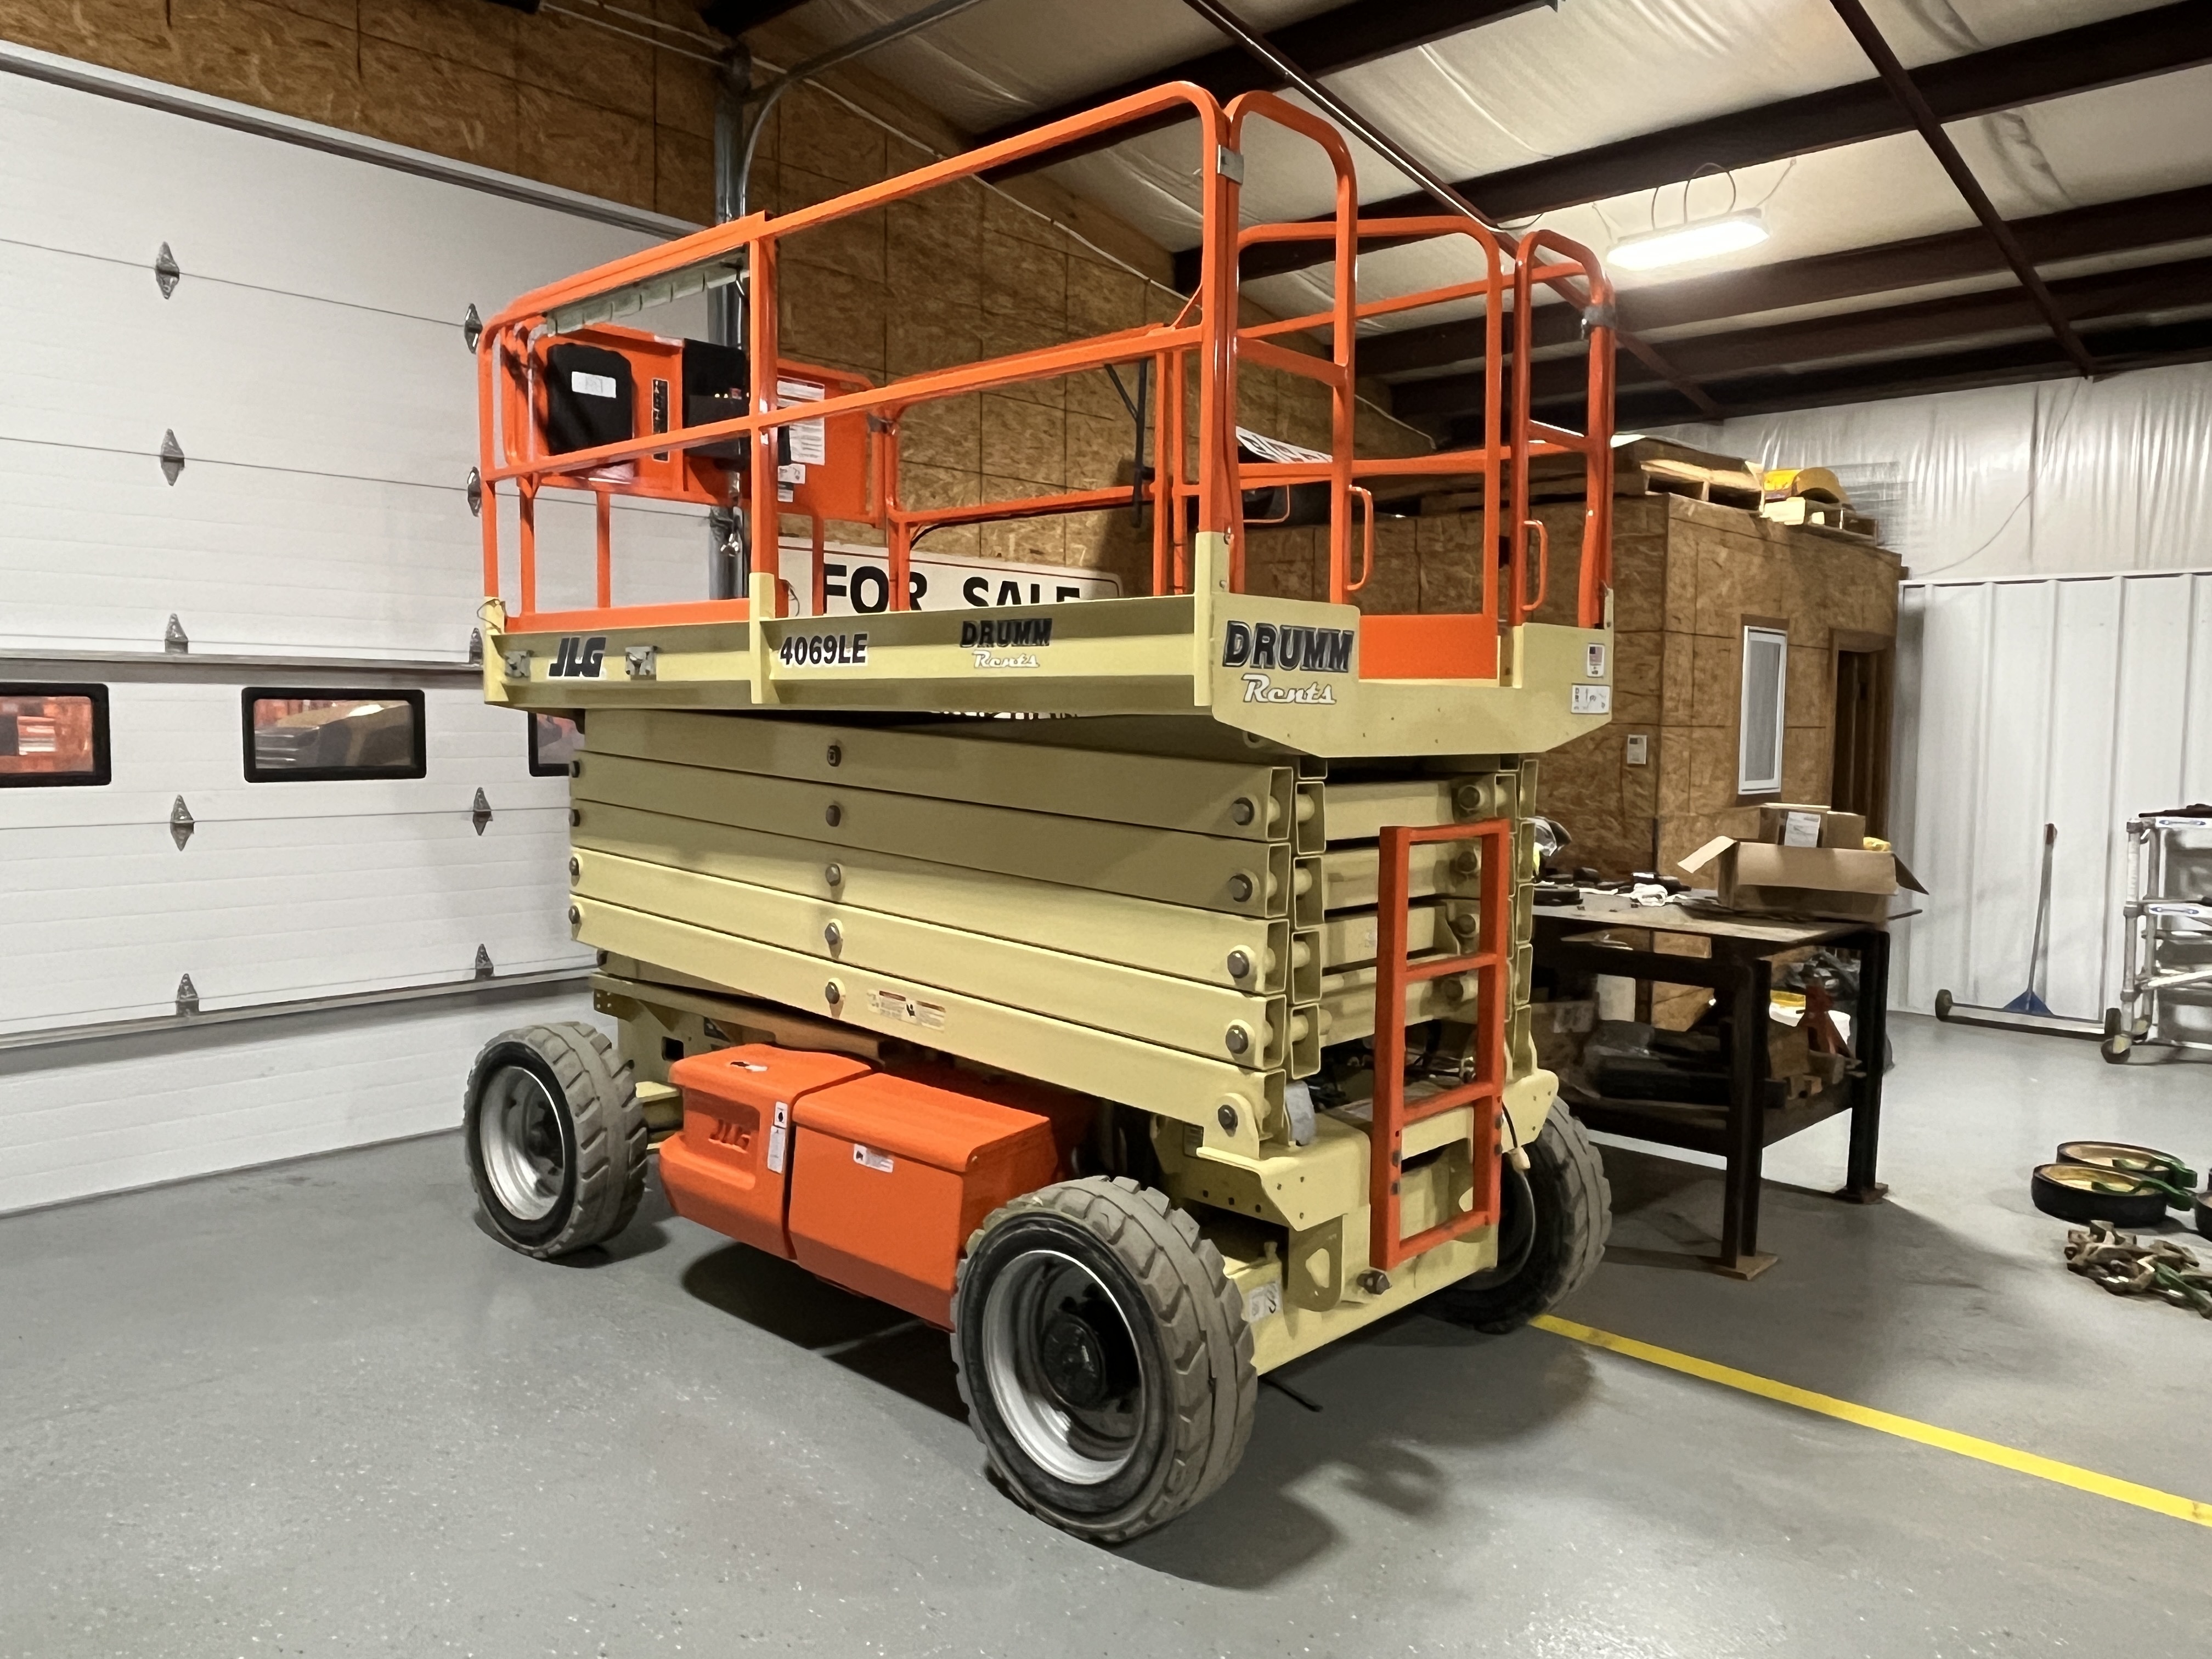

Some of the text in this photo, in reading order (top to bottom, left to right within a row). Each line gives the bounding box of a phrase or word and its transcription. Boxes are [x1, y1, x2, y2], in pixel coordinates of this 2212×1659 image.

[823, 563, 927, 614] FOR
[960, 618, 1052, 648] DRUMM
[1222, 620, 1355, 673] DRUMM
[549, 637, 606, 677] JLG
[780, 634, 868, 665] 4069LE
[972, 649, 1040, 668] Rents
[1241, 673, 1337, 704] Rents
